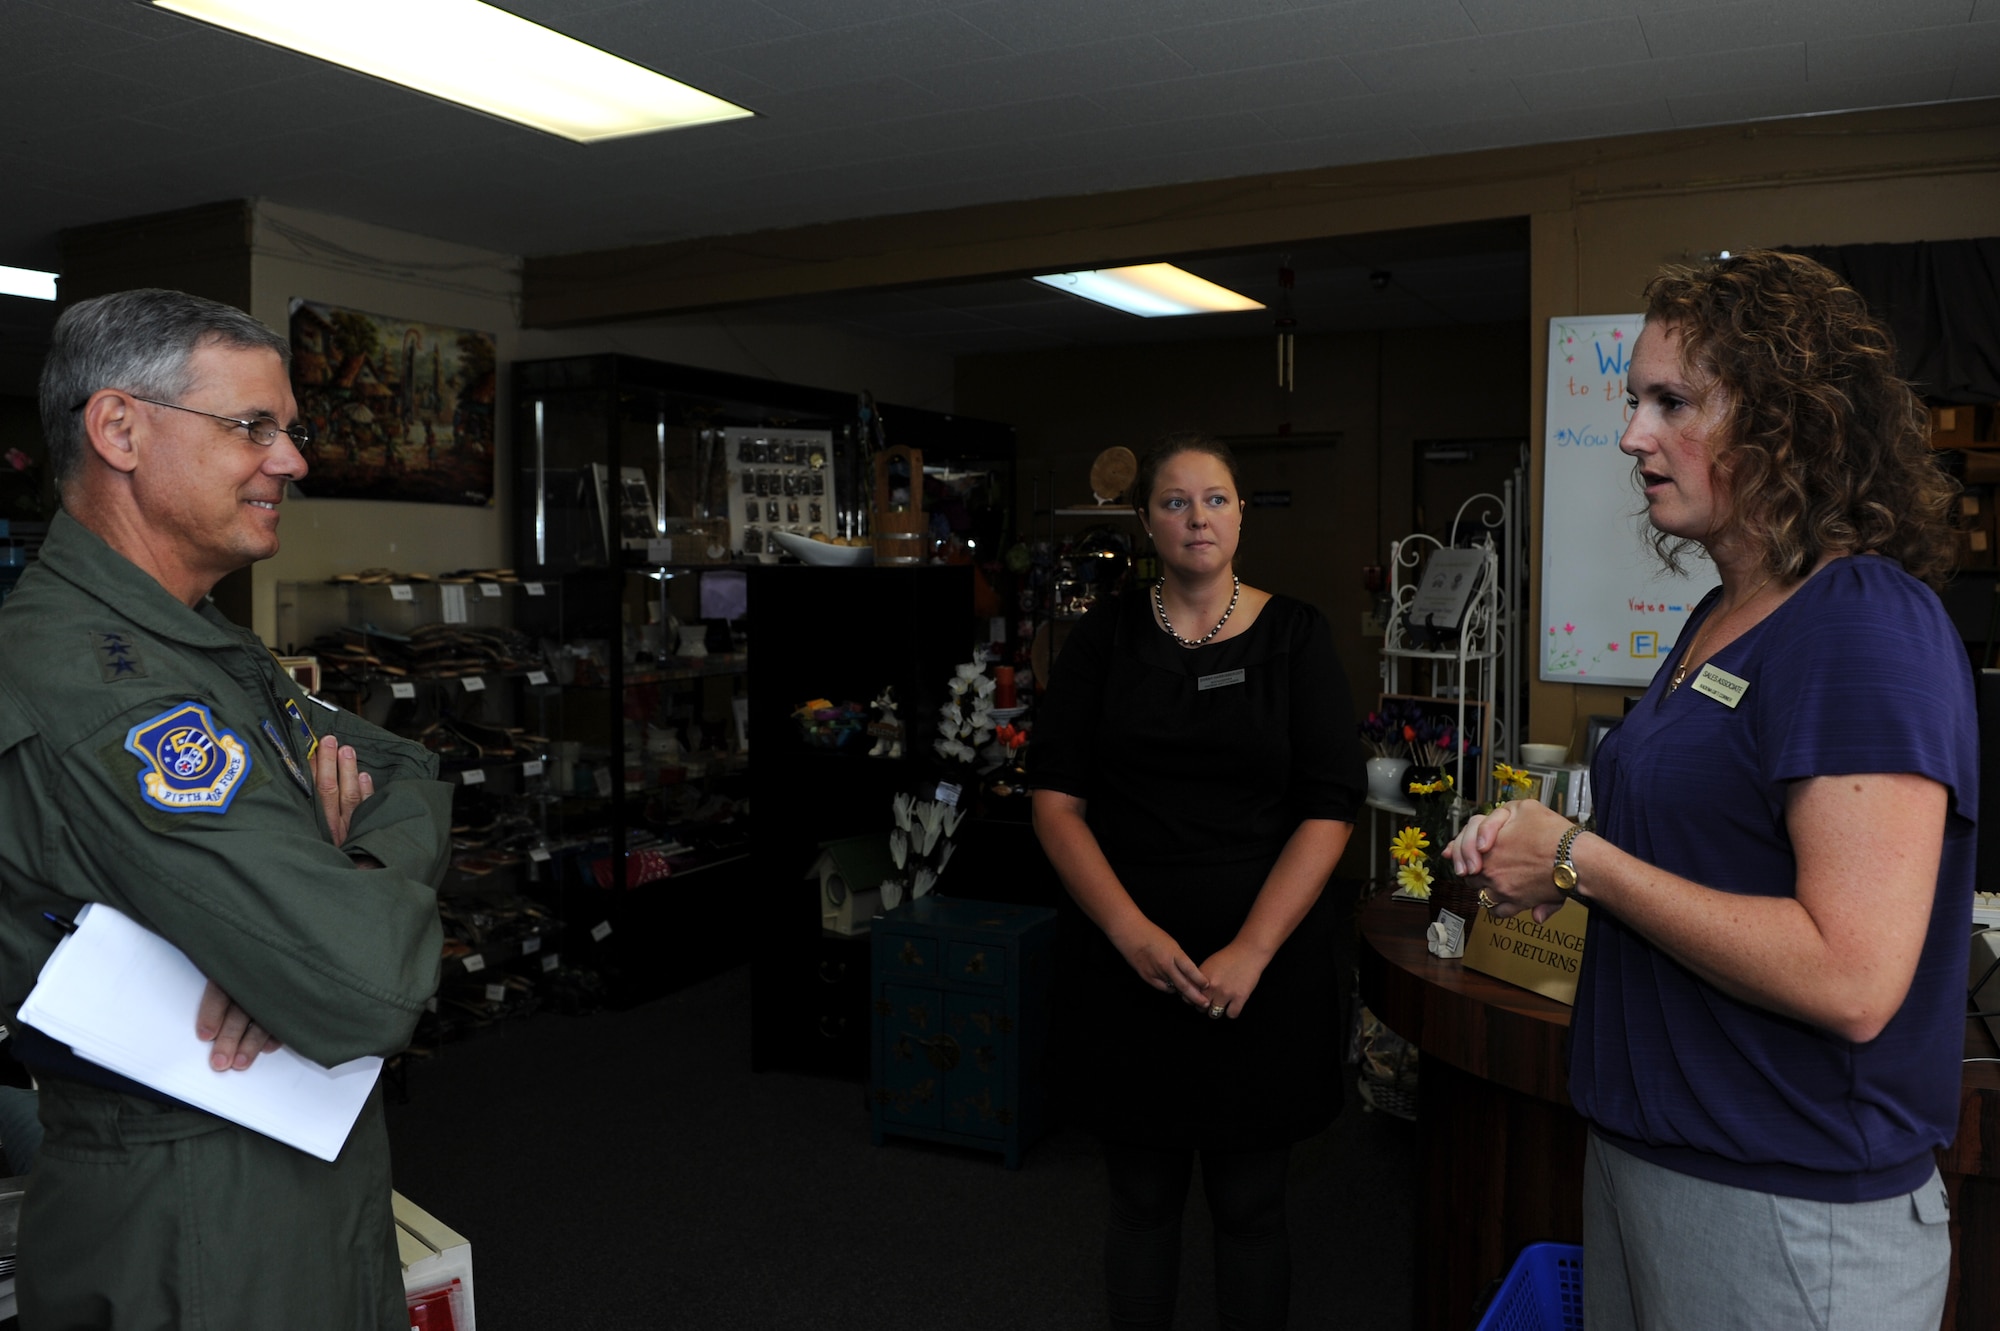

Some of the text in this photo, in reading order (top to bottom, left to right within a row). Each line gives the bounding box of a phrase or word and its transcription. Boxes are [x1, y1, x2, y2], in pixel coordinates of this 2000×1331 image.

[1567, 376, 1590, 396] to
[1702, 670, 1744, 694] SALES ASSOCIATE
[164, 757, 240, 802] FIFTH AIR FORCE
[1483, 911, 1504, 926] NO
[1488, 932, 1512, 951] NO
[1512, 940, 1578, 973] RETURNS
